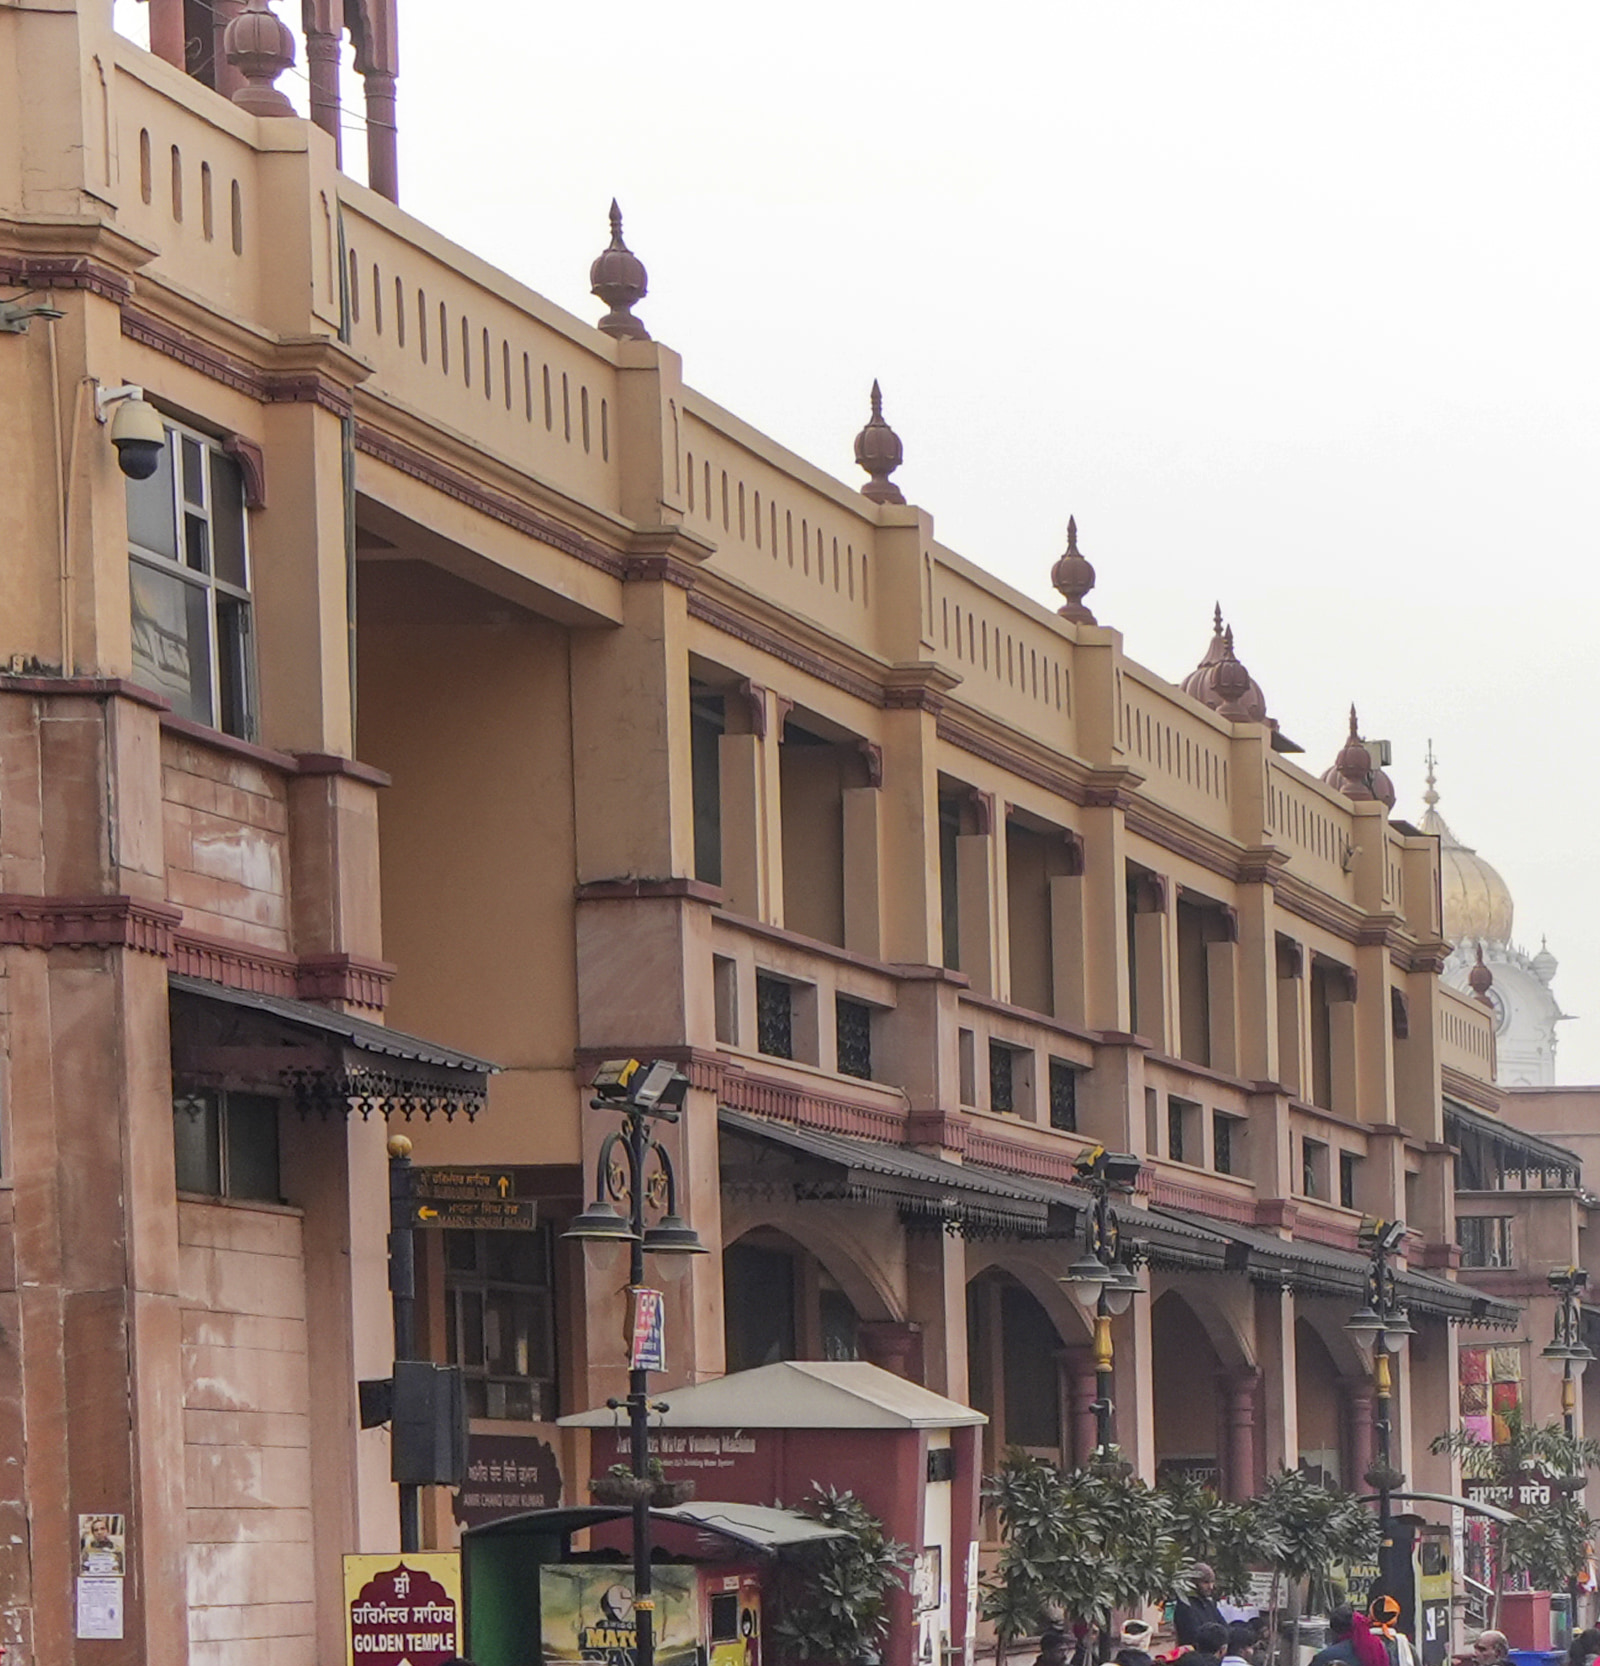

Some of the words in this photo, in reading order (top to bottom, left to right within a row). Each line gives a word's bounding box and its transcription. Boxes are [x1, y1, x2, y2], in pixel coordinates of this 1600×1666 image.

[352, 1602, 409, 1624] ਹਰਿਮੰਦਰ
[412, 1601, 454, 1624] ਸਾਹਿਬ
[354, 1634, 404, 1652] GOLDEN
[406, 1633, 455, 1651] TEMPLE
[586, 1628, 640, 1648] MATC
